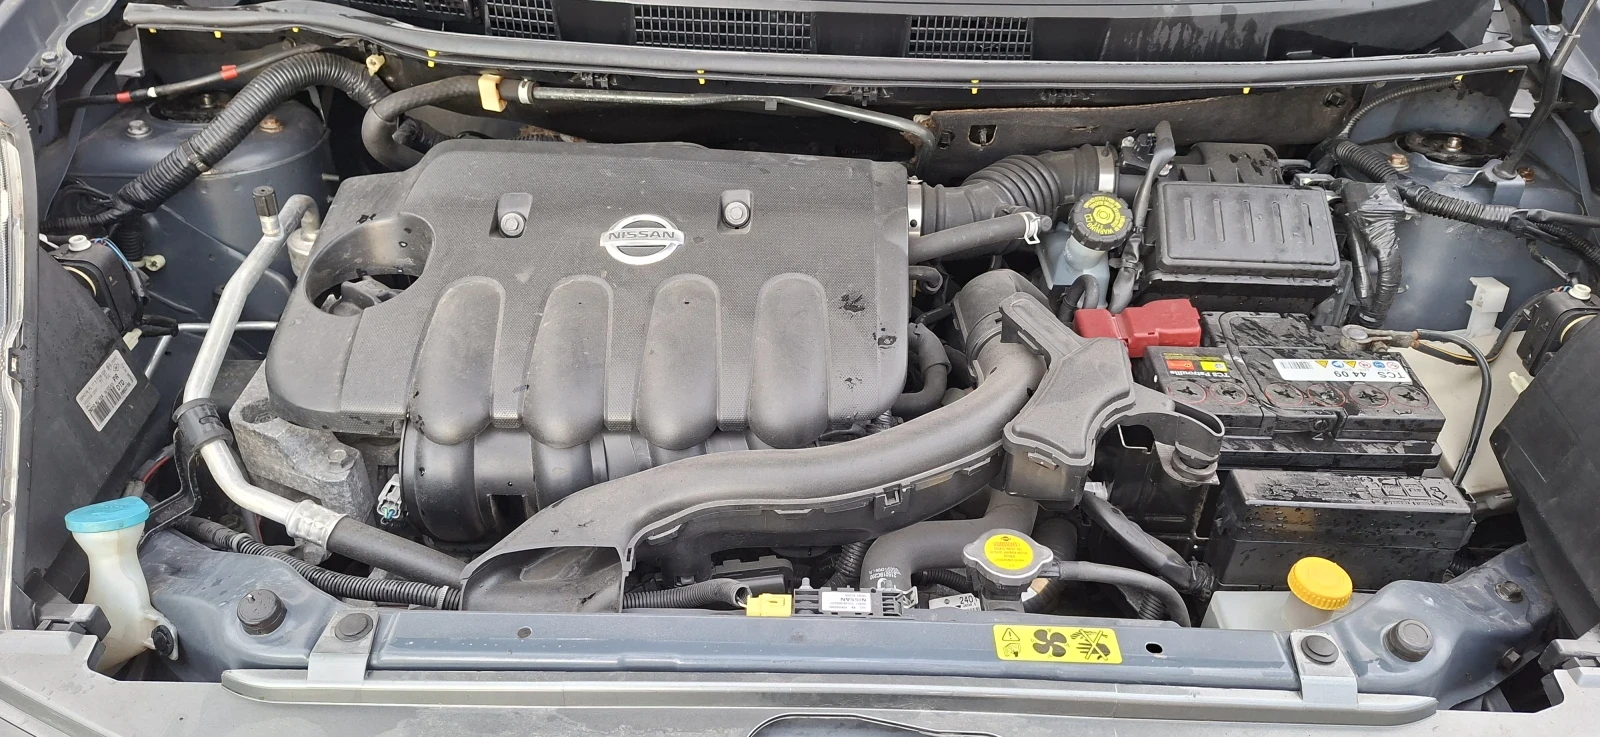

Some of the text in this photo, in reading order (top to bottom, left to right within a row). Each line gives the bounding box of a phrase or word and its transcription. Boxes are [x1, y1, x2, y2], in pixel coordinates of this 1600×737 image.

[1086, 222, 1114, 235] WARNING
[608, 230, 675, 240] NISSAN
[1377, 371, 1406, 379] TCS
[959, 595, 974, 605] 240
